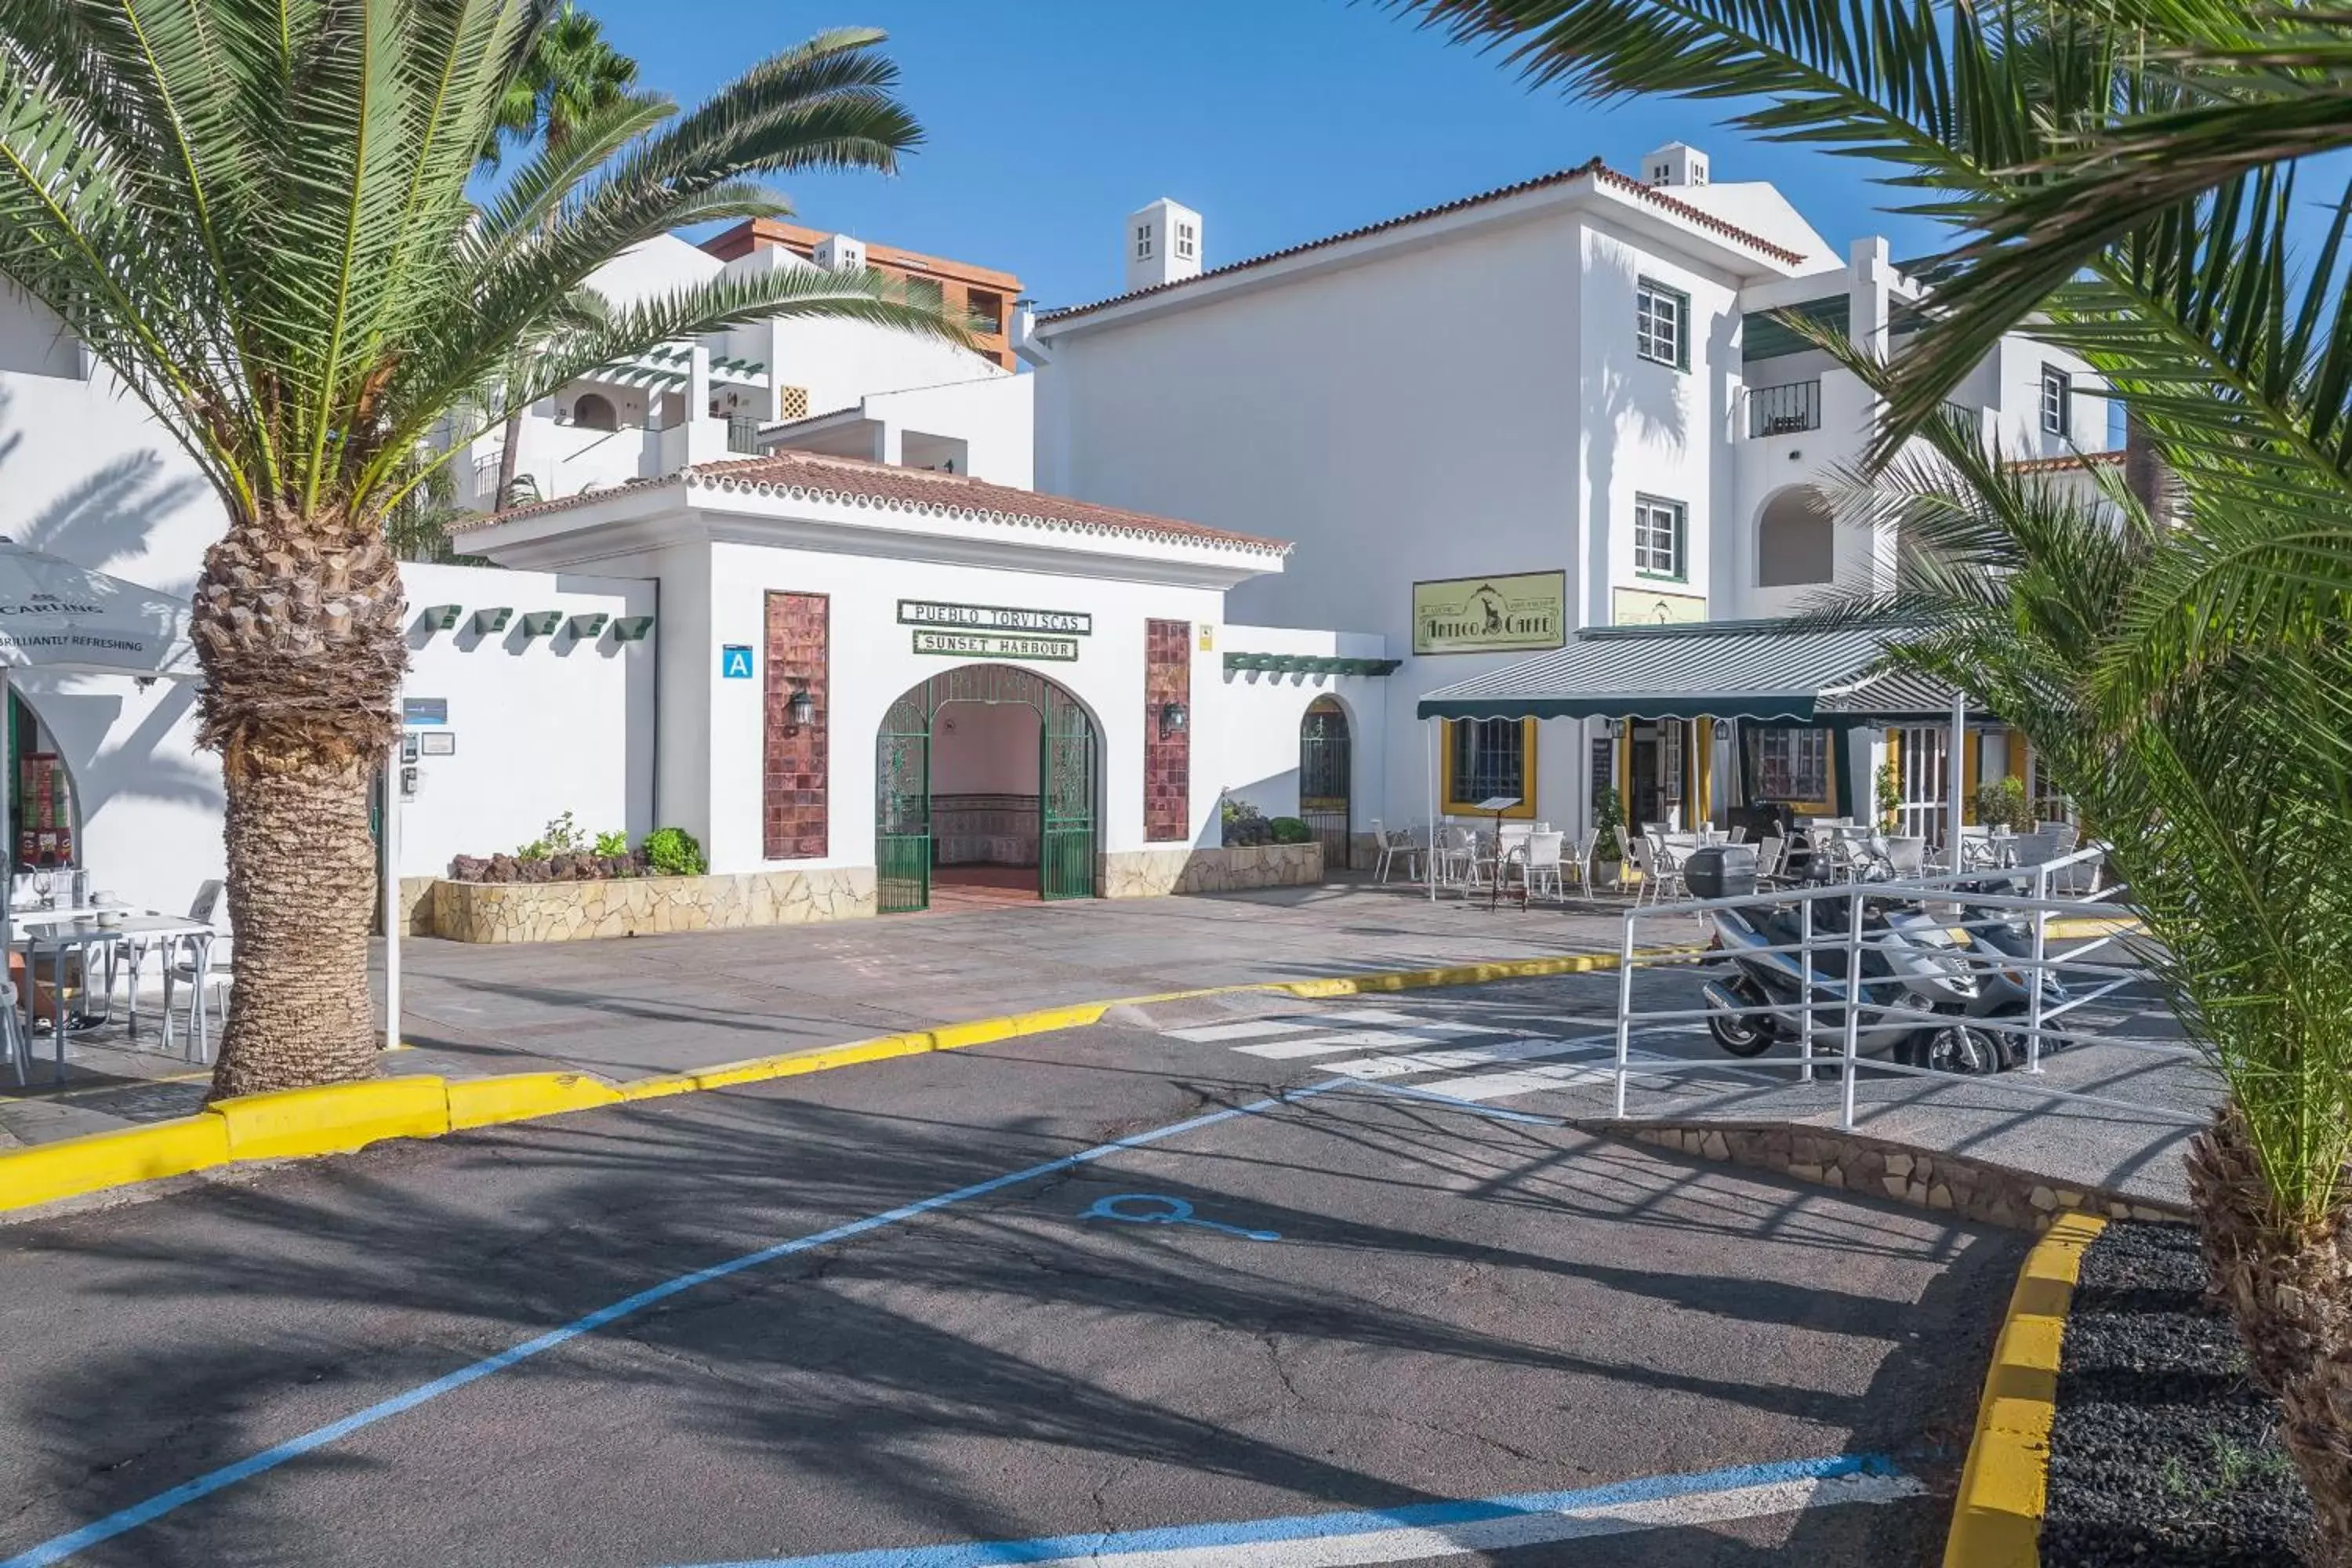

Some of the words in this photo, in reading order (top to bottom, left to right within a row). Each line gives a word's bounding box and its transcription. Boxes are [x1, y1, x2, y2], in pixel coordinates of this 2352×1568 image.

[915, 606, 979, 623] PUEBLO
[990, 611, 1078, 630] TORVISCAS
[72, 636, 143, 652] REFRESHING
[924, 636, 989, 652] SUNSET
[1000, 640, 1068, 655] HARBOUR
[730, 653, 747, 675] A
